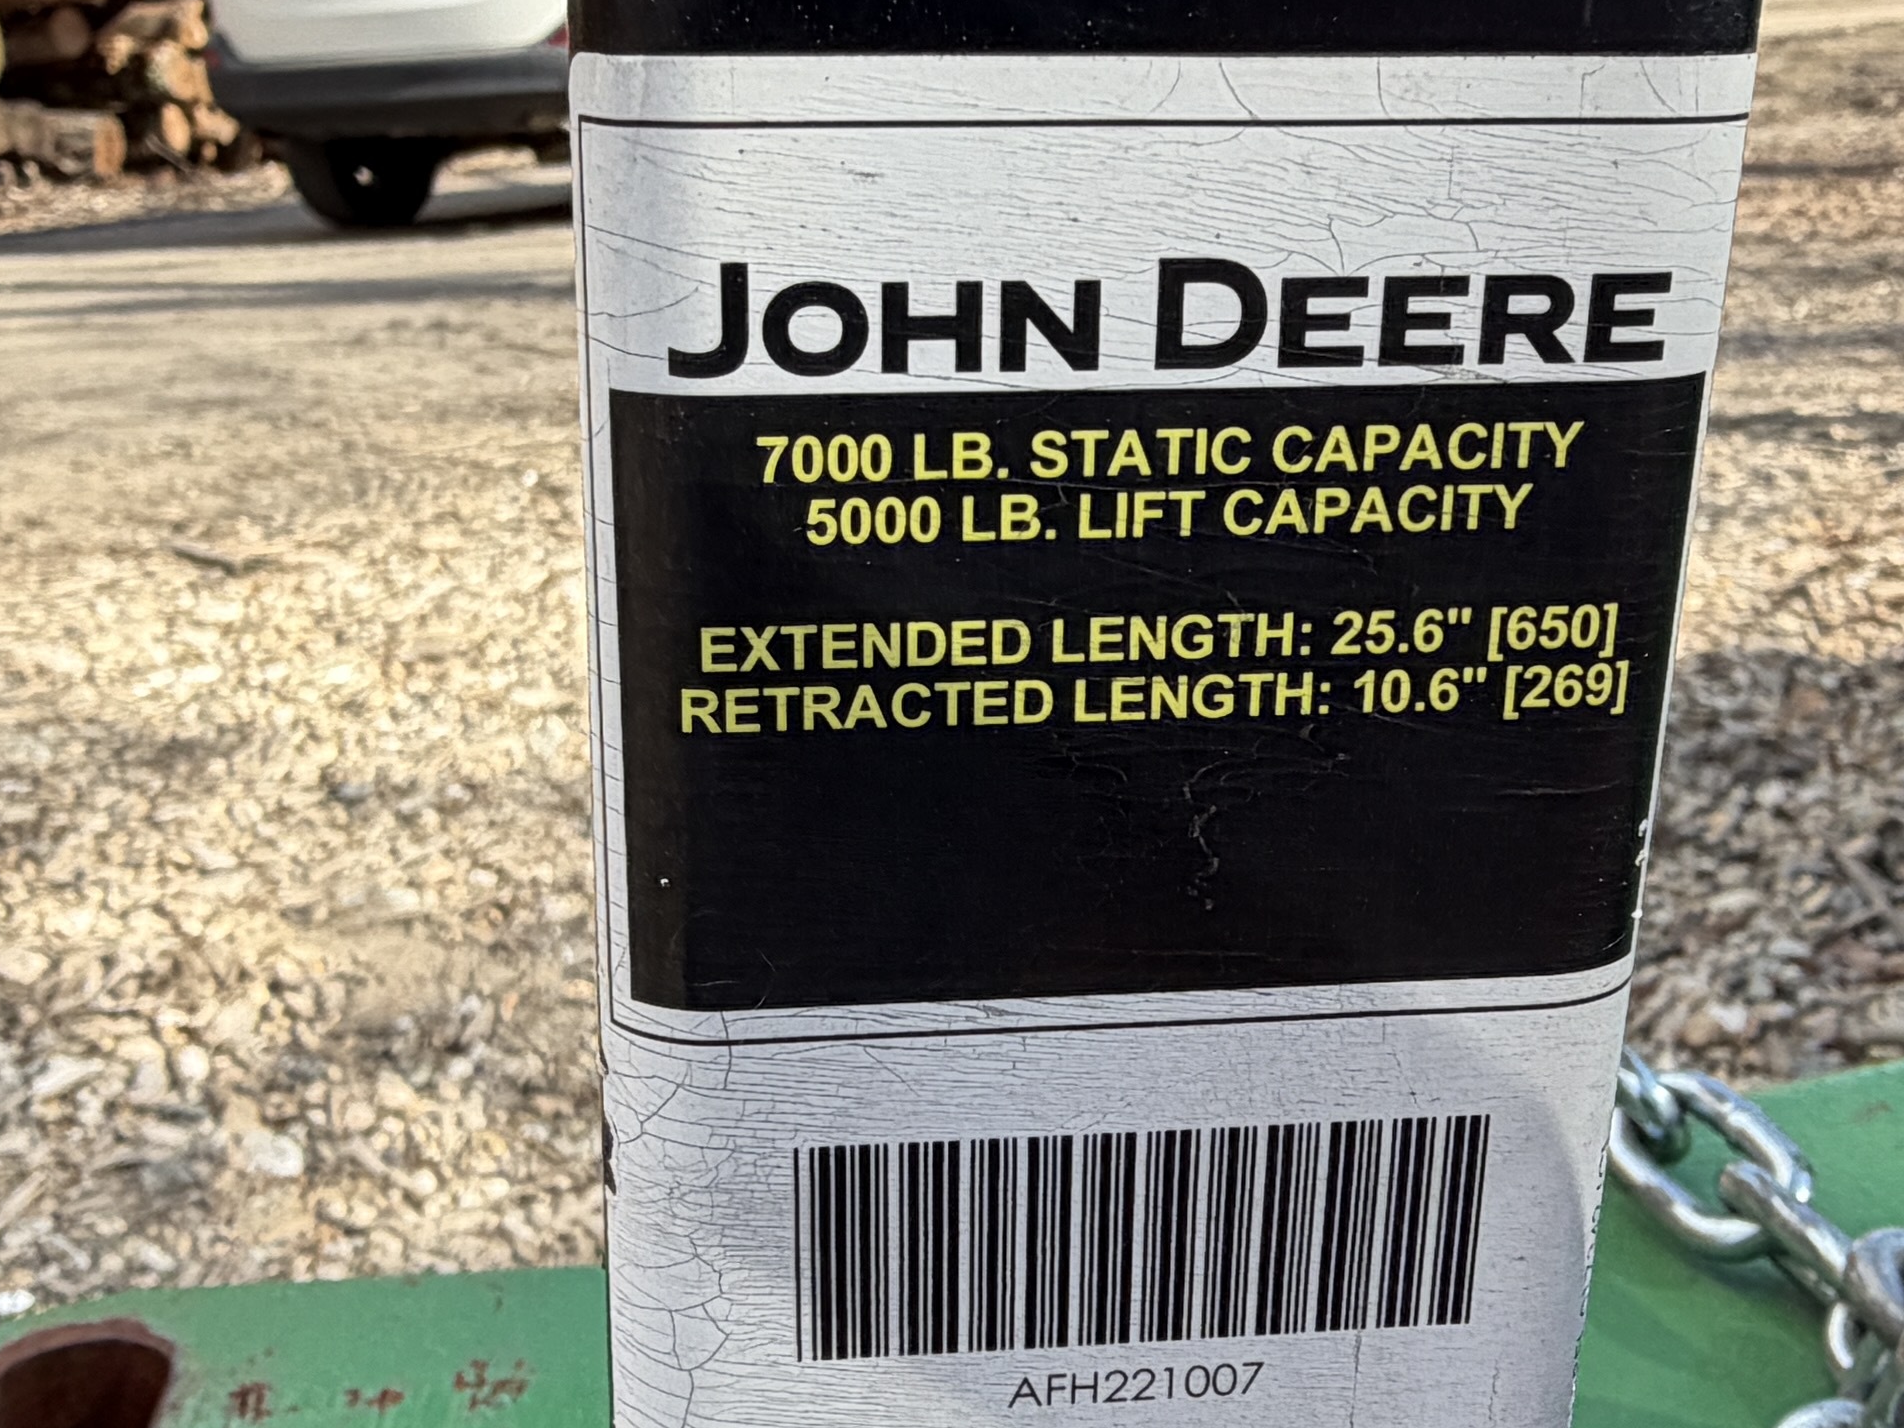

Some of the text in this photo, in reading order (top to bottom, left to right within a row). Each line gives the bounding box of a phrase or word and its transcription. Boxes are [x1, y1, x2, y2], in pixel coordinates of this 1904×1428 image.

[668, 258, 1672, 378] JOHN DEERE
[758, 423, 1582, 483] 7000 LB. STATIC CAPACITY
[809, 485, 1531, 545] 5000 LB. LIFT CAPACITY
[702, 605, 1618, 672] EXTENDED LENGTH: 25.6" [650]
[682, 662, 1629, 732] RETRACTED LENGTH: 10.6" [269]
[1007, 1361, 1265, 1409] AFH221007
